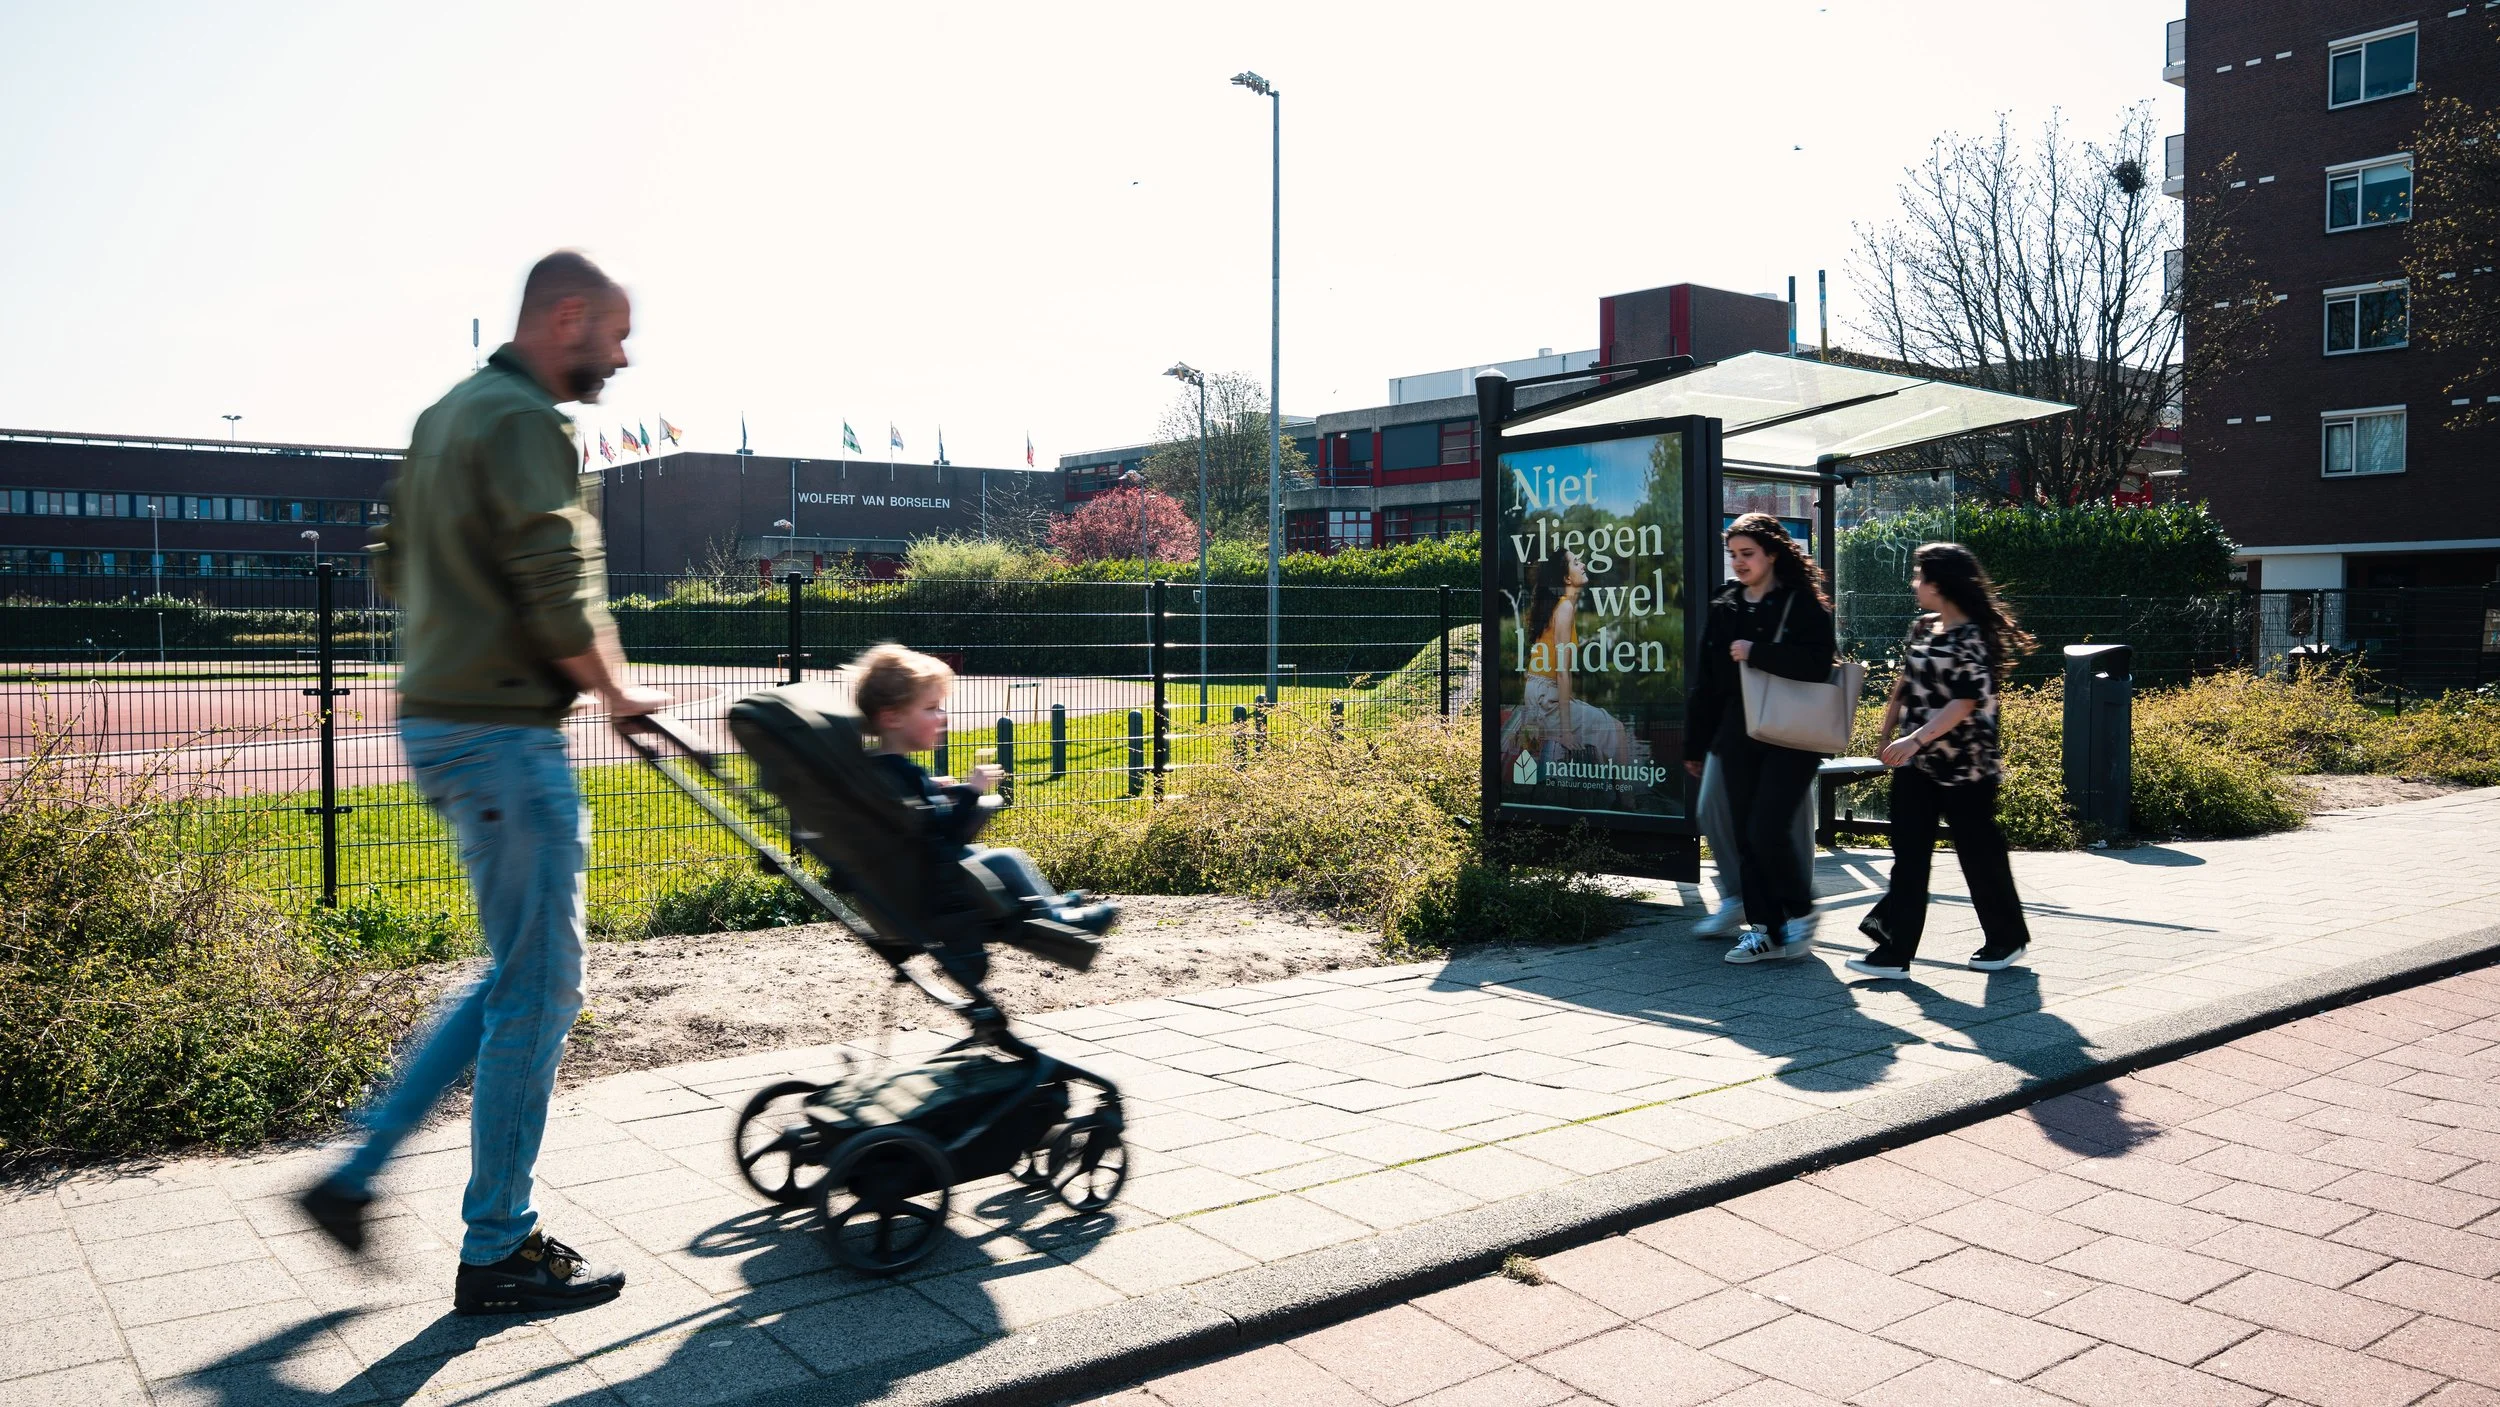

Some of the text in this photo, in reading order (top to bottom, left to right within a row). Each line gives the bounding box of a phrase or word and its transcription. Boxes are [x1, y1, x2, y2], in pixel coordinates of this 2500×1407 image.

[798, 492, 950, 509] WOLFERT VAN BORSELEN
[1512, 465, 1598, 510] Niet
[1510, 517, 1664, 574] vliegen
[1589, 568, 1666, 617] wel
[1515, 626, 1666, 673] landen
[1545, 758, 1667, 787] natuurhuisje
[1546, 778, 1633, 793] De natuur opent je ogen
